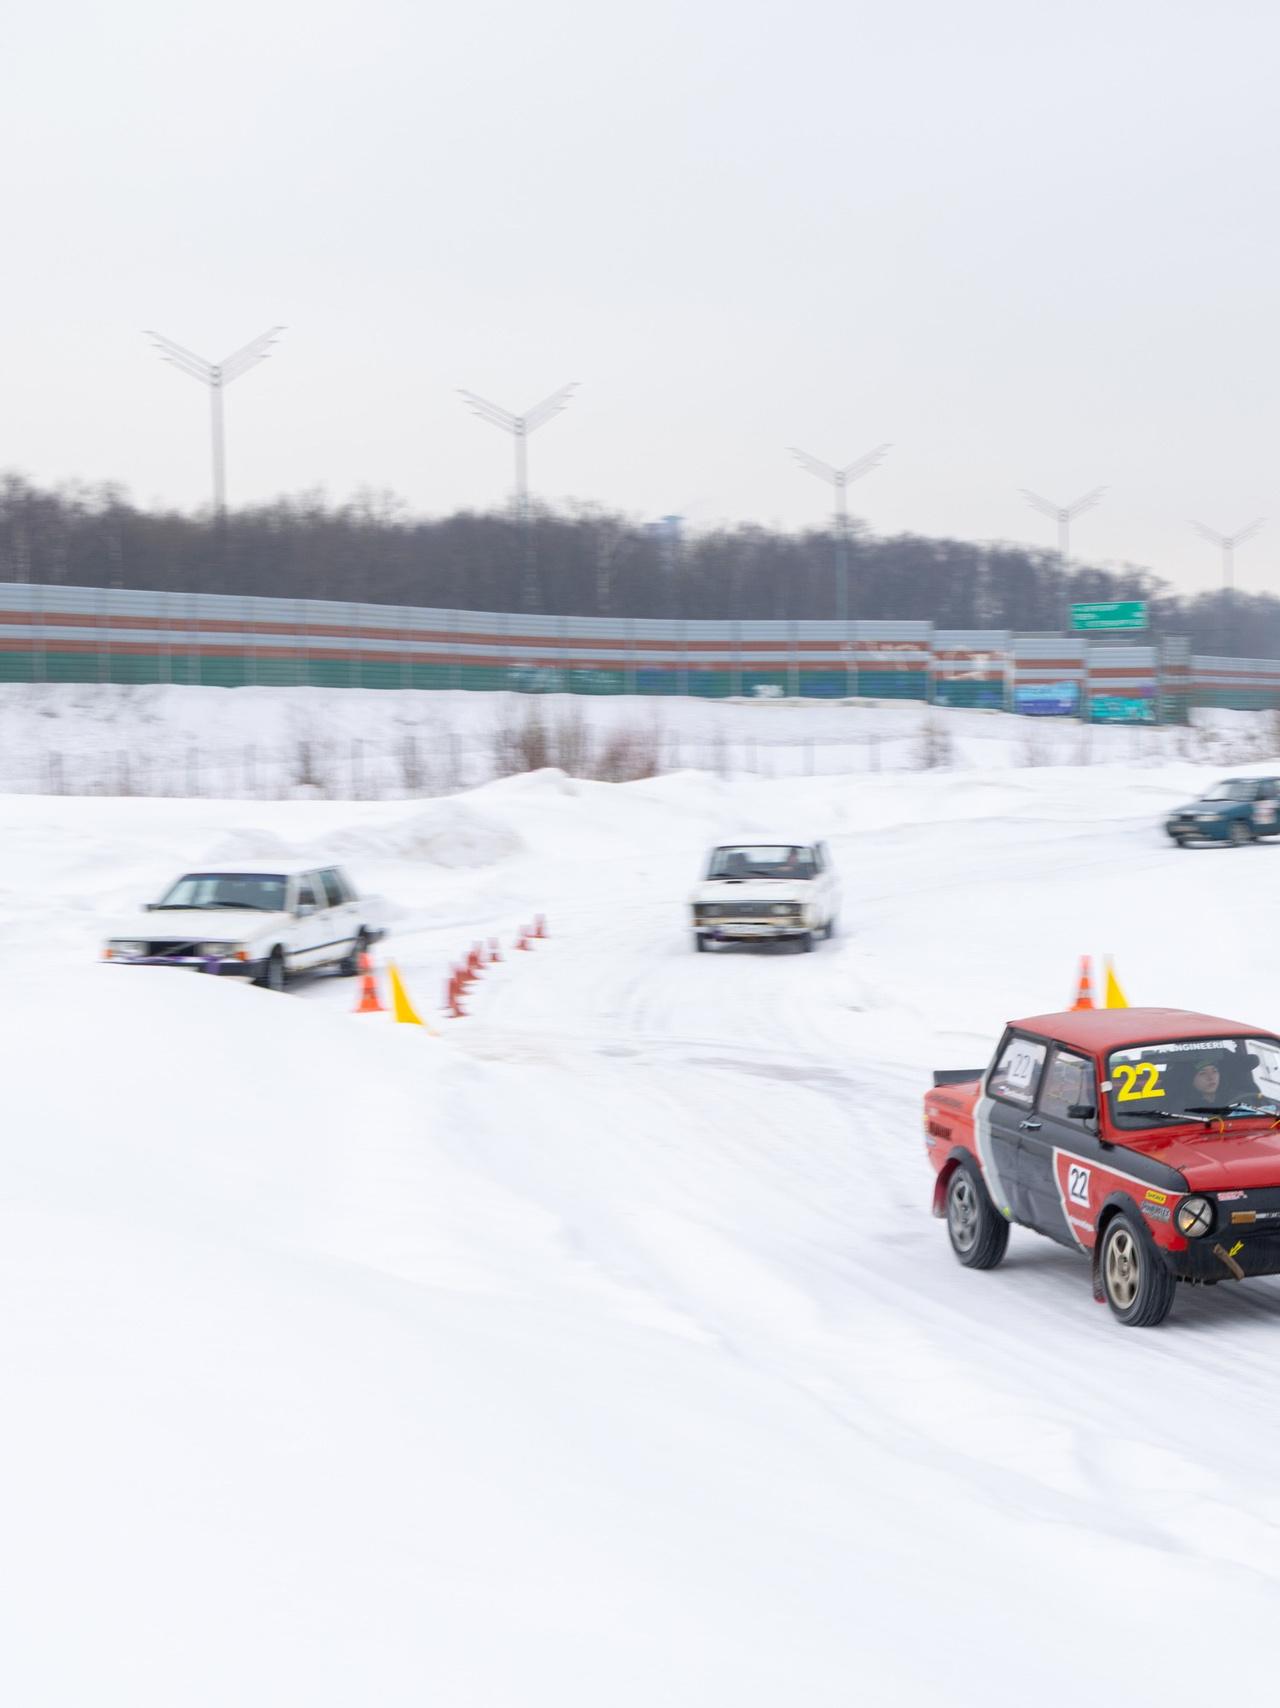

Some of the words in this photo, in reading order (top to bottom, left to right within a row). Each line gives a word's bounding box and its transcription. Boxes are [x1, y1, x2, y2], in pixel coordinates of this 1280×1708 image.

[1013, 1053, 1032, 1079] 22
[1112, 1062, 1166, 1102] 22
[1070, 1167, 1089, 1201] 22
